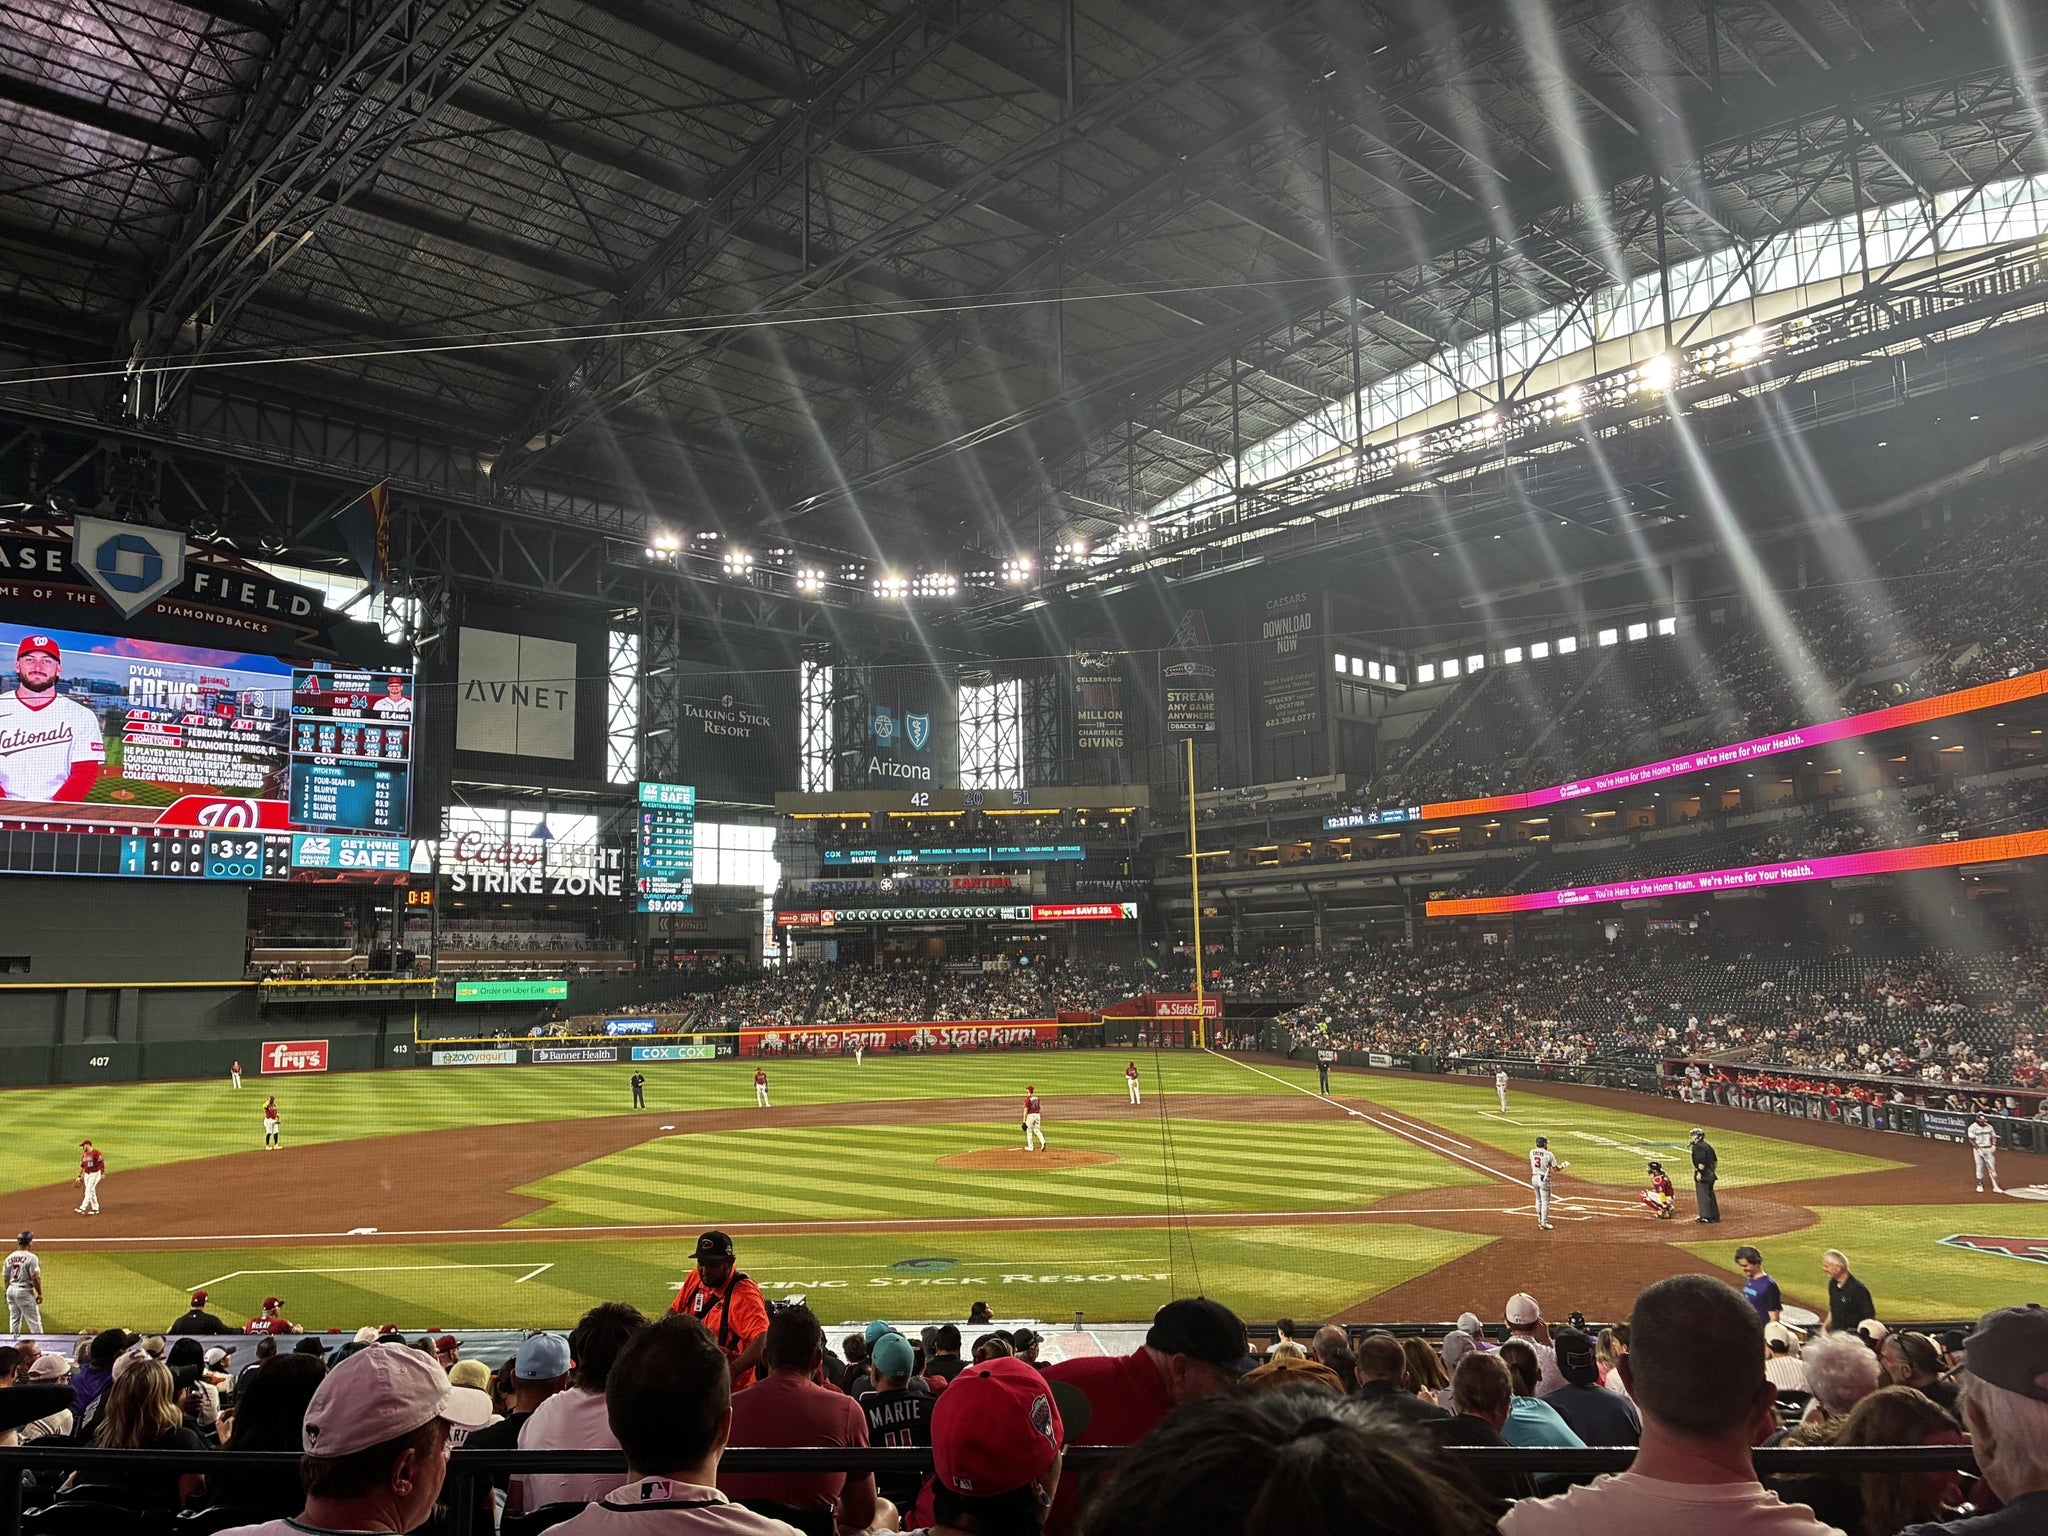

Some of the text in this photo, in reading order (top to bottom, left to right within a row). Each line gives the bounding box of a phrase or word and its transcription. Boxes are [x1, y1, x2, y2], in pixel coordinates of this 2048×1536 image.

[33, 589, 52, 599] OF
[67, 592, 96, 604] THE
[194, 573, 311, 616] FIELD
[1266, 592, 1307, 610] CAESARS
[157, 604, 268, 633] DIAMONDBACKS
[1263, 613, 1311, 639] DOWNLOAD
[1277, 633, 1298, 654] NOW
[130, 665, 162, 678] DYLAN
[129, 677, 198, 712] CREWS
[254, 691, 265, 708] 3
[464, 679, 569, 711] AVNET
[1167, 692, 1214, 702] STREAM
[350, 695, 368, 708] 34
[1168, 703, 1215, 711] ANY GAME
[1275, 700, 1305, 711] LOCATION
[254, 708, 264, 717] RF
[292, 705, 314, 714] COX
[332, 707, 361, 717] SLURVE
[1078, 711, 1123, 720] MILLION
[1168, 712, 1215, 720] ANYWHERE
[208, 717, 223, 727] 203
[256, 722, 272, 731] R/R
[704, 720, 751, 737] RESORT
[188, 728, 260, 742] FEBRUARY 26, 2002
[133, 736, 278, 755] HOMETOWN ALTAMONTE SPRINGS, FL
[1078, 738, 1124, 748] GIVING
[124, 746, 242, 763] HE PLAYED WITH PAUL SKENES AT
[123, 755, 270, 773] LOUISIANA STATE UNIVERSITY, WHERE THE
[314, 757, 336, 766] COX
[1595, 734, 1804, 789] You're Here for the Home Team. We're Here for Your Health.
[123, 763, 263, 780] TWO CONTRIBUTED TO THE TIGERS' 2023
[868, 756, 931, 781] Arizona
[122, 771, 264, 788] COLLEGE WORLD SERIES CHAMPIONSHIP
[314, 776, 390, 790] FOUR-SEAM 94.1
[313, 785, 338, 795] SLURVE
[313, 794, 336, 803] SINKER
[660, 791, 691, 805] SAFE
[910, 790, 1029, 807] 42 20 51
[313, 802, 337, 812] SLURVE
[312, 811, 336, 821] SLURVE
[1327, 815, 1364, 828] 12:31 PM
[219, 840, 258, 860] 3 2
[341, 840, 366, 849] GET
[453, 830, 622, 870] Coors LIGHT
[339, 849, 400, 868] SAFE
[824, 850, 841, 858] COX
[451, 870, 544, 894] STRIKE
[552, 874, 622, 896] ZONE
[810, 876, 1012, 892] ESTRELLA JALISCO CANTINA
[1595, 888, 1613, 899] You're
[1614, 887, 1629, 896] Here
[1630, 885, 1639, 894] for
[1640, 883, 1651, 893] the
[1653, 882, 1673, 892] Home
[1674, 880, 1695, 890] Team.
[1699, 876, 1723, 887] We're
[1723, 874, 1743, 884] Here
[1744, 872, 1757, 881] for
[1758, 870, 1779, 880] Your
[1780, 864, 1814, 878] Health.
[648, 899, 684, 912] $9,009
[1037, 908, 1051, 917] Sign
[1053, 908, 1062, 916] up
[1076, 907, 1098, 915] SAVE
[480, 987, 500, 995] Order
[393, 1044, 407, 1054] 413
[550, 1049, 611, 1060] Banner Health
[642, 1047, 706, 1058] COX COX
[717, 1047, 732, 1055] 374
[89, 1056, 110, 1067] 407
[268, 1044, 320, 1069] fry's
[1534, 1156, 1541, 1169] 3
[13, 1264, 20, 1279] 7
[870, 1272, 1171, 1287] STICK RESORT
[251, 1321, 272, 1329] McKAY
[869, 1399, 920, 1429] MARTE
